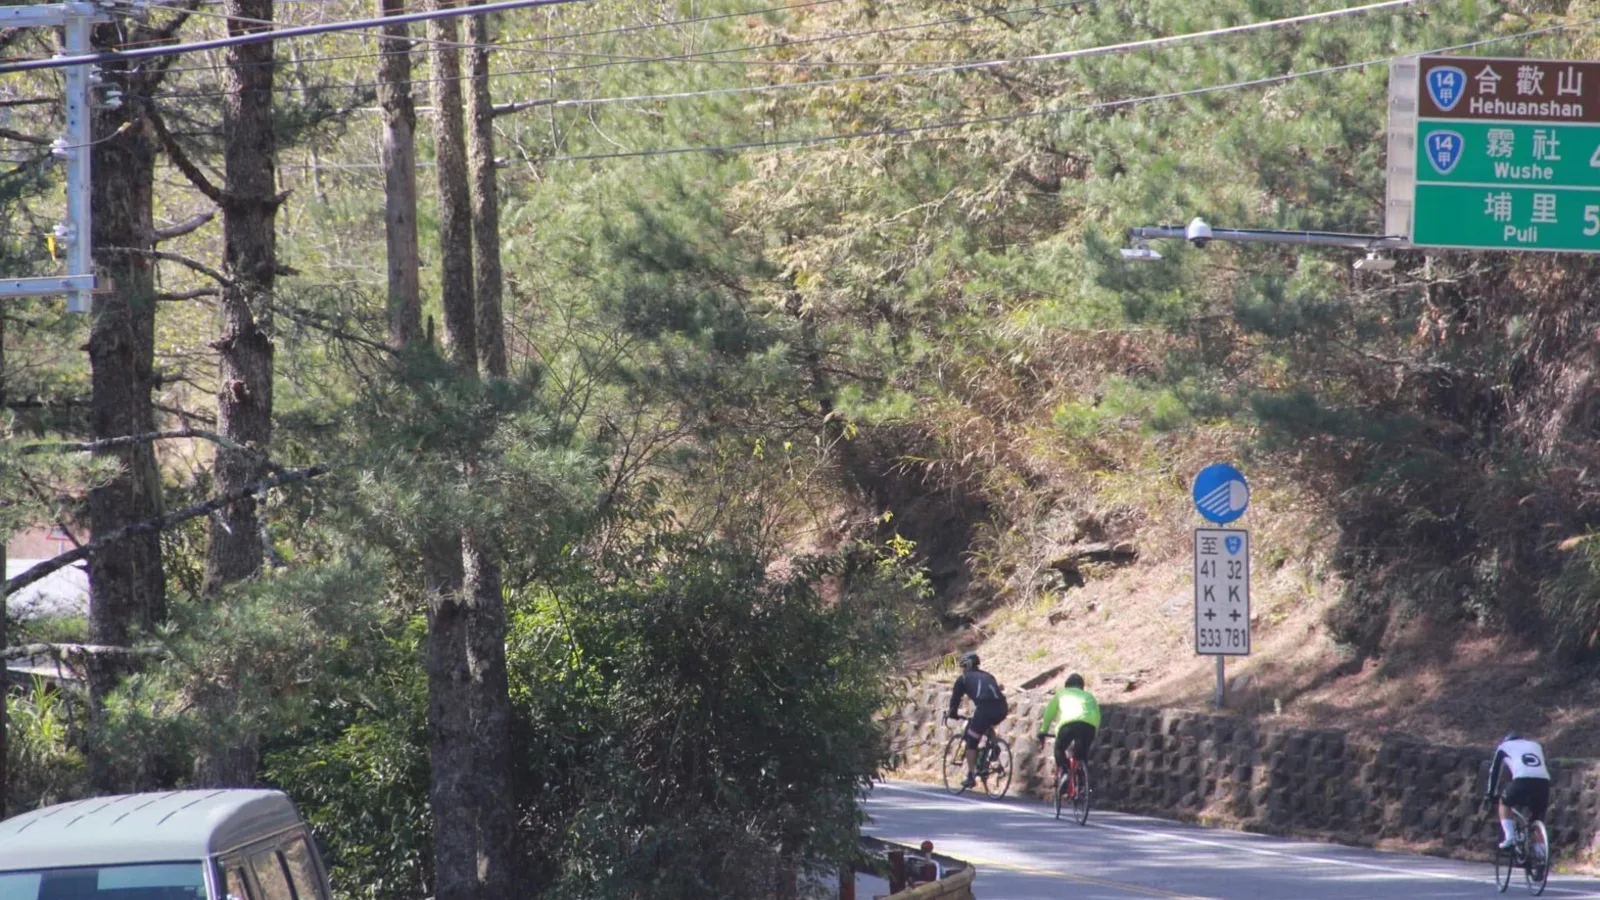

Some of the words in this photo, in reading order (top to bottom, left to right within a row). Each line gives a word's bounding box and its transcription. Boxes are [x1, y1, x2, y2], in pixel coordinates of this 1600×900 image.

[1436, 72, 1455, 87] 14
[1475, 64, 1583, 96] 合歡山
[1439, 88, 1452, 104] 甲
[1469, 97, 1583, 117] Hehuanshan
[1434, 136, 1453, 151] 14
[1486, 128, 1561, 161] 霧社
[1438, 152, 1451, 168] 甲
[1494, 162, 1553, 180] Wushe
[1484, 192, 1558, 223] 埔里
[1503, 225, 1538, 243] Puli
[1200, 536, 1219, 555] 至
[1200, 559, 1216, 578] 41
[1227, 560, 1242, 579] 32
[1204, 585, 1216, 602] K
[1229, 585, 1241, 603] K
[1200, 628, 1221, 647] 533
[1225, 628, 1246, 647] 781
